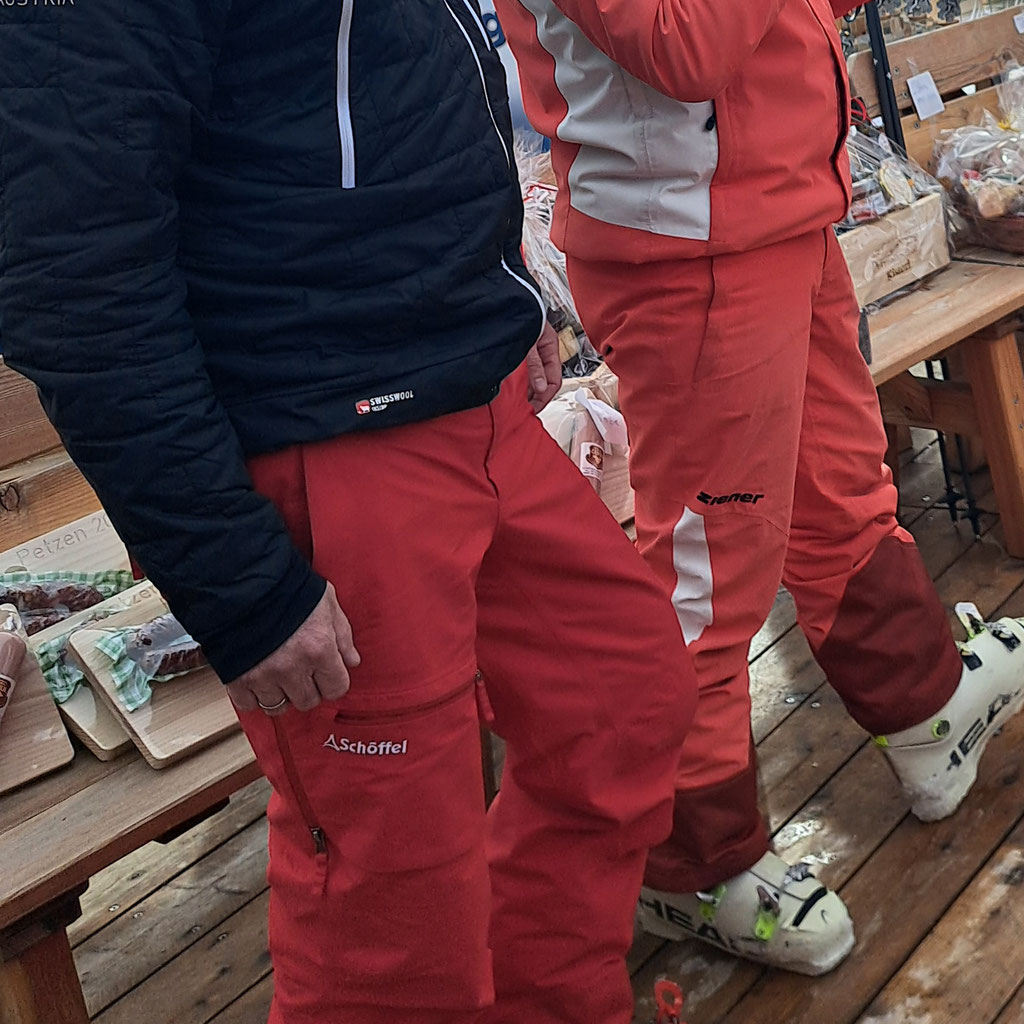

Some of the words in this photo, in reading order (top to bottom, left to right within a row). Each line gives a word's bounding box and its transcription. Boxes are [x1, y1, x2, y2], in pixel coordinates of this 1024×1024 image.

[369, 389, 414, 406] SWISSWOOL
[16, 528, 88, 566] Petzen
[339, 738, 407, 755] Schöffel
[641, 896, 742, 954] HEA
